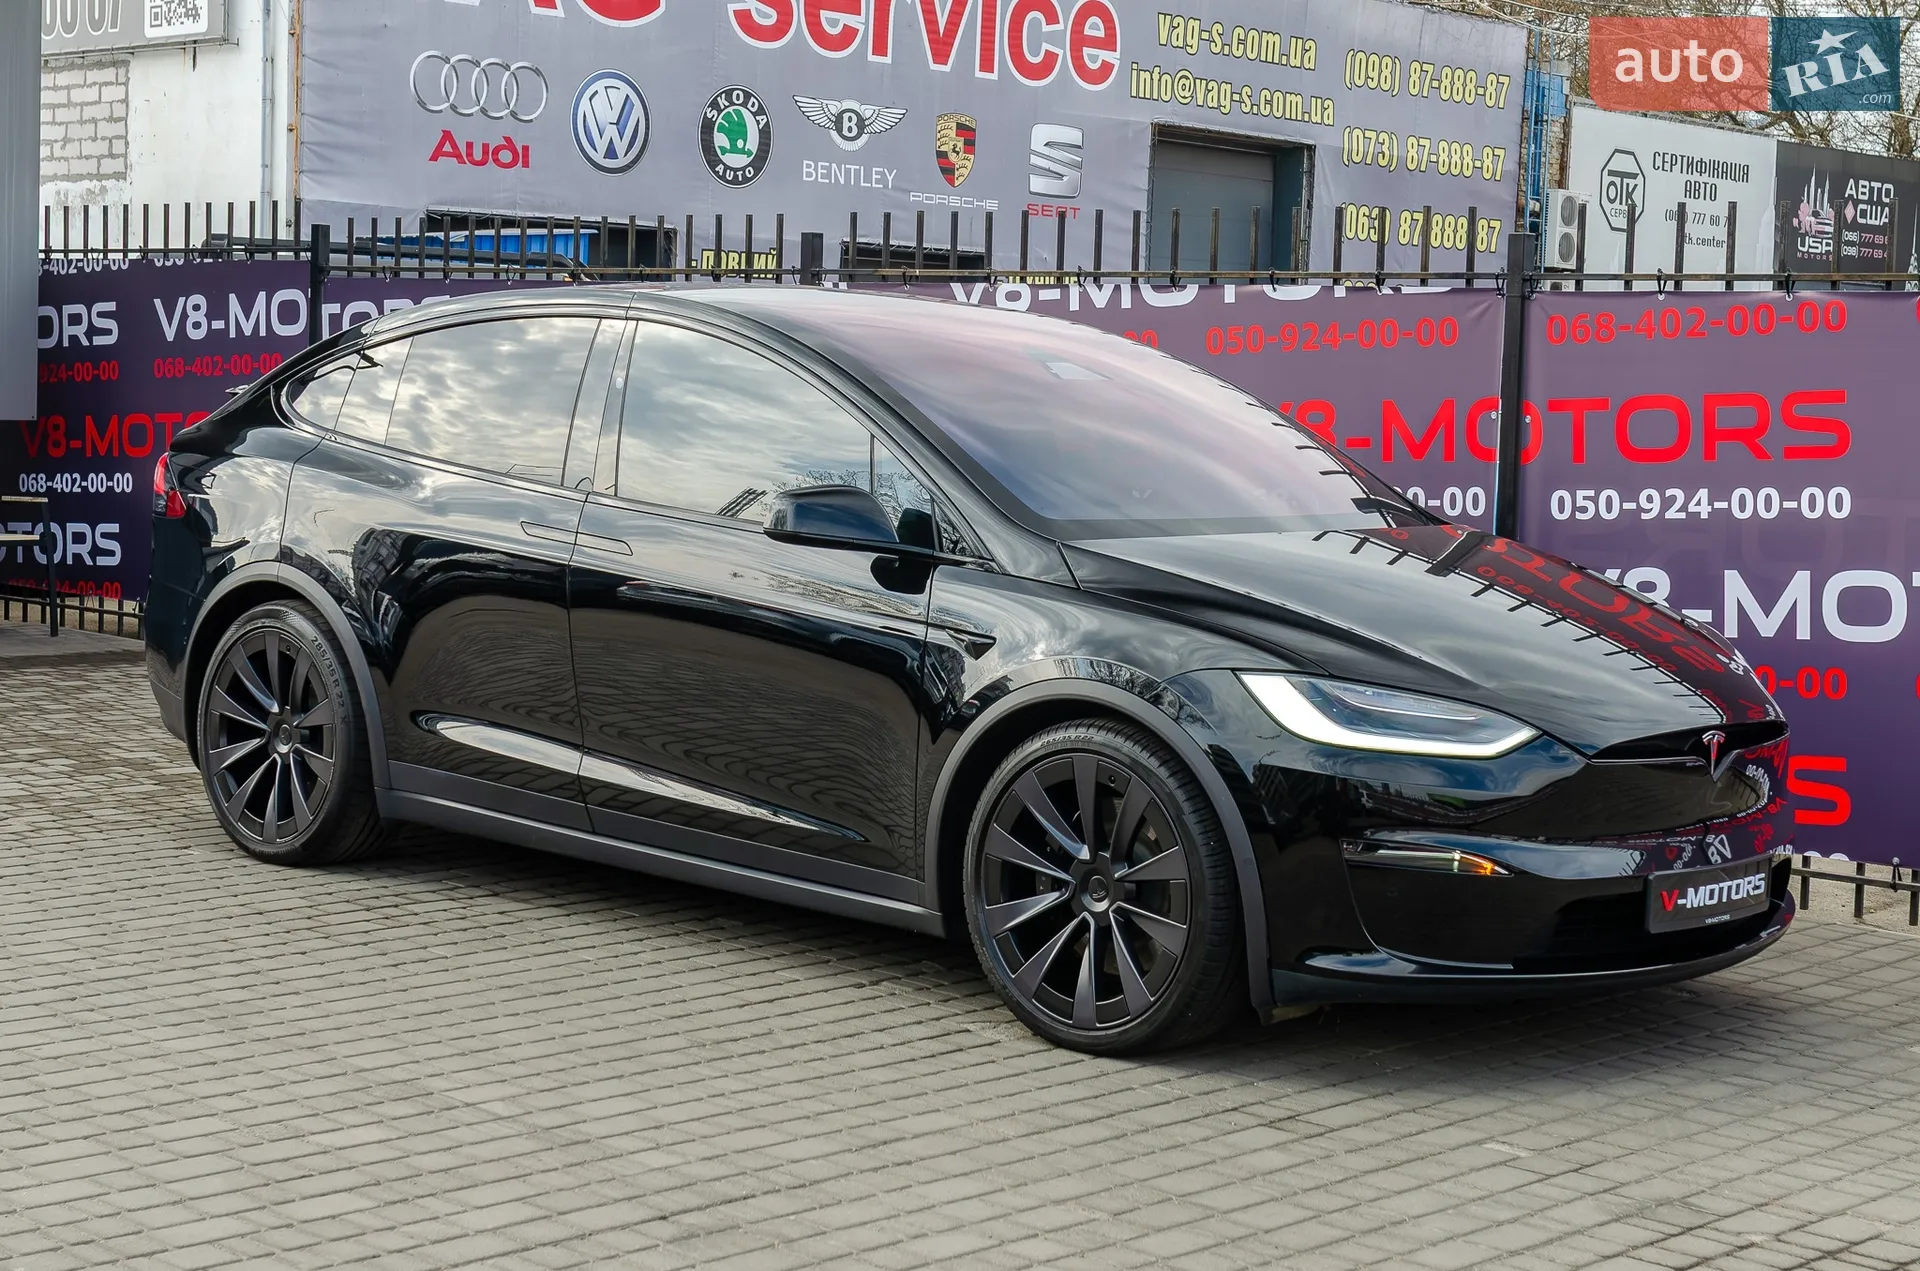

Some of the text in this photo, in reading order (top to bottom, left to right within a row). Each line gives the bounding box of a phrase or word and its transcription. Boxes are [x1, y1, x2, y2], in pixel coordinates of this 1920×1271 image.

[1157, 12, 1317, 71] vag-s.com.ua
[1130, 61, 1335, 127] info@vag-s.com.ua
[1344, 48, 1511, 109] (098) 87-888-87
[937, 114, 976, 128] PORSCHE
[428, 129, 530, 169] Audi
[1342, 126, 1506, 181] (073) 87-888-87
[715, 163, 755, 182] AUTO
[802, 160, 898, 189] BENTLEY
[1652, 151, 1750, 184] СЕРТИФІКАЦІЯ
[909, 192, 999, 211] PORSCHE
[1684, 179, 1718, 202] АВТО
[1844, 178, 1895, 203] АВТО
[1205, 316, 1459, 355] 050-924-00-00
[1546, 299, 1848, 345] 068-402-00-00
[19, 472, 133, 493] 068-402-00-00
[1550, 486, 1852, 520] 050-924-00-00
[1661, 873, 1766, 912] V-MOTORS
